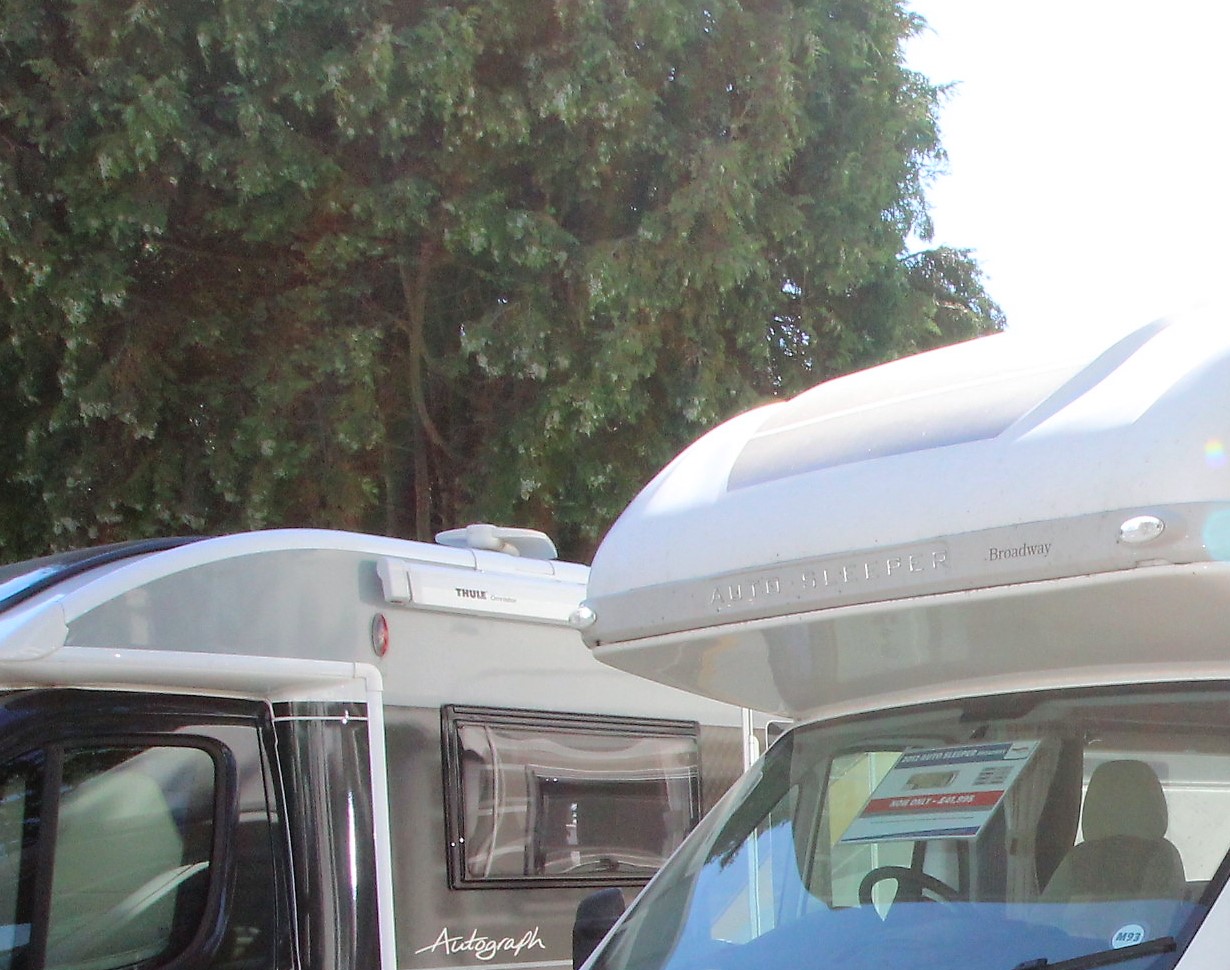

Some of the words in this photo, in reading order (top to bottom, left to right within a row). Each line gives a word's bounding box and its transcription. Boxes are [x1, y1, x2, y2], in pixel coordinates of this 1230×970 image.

[988, 542, 1052, 561] Broadway
[710, 578, 781, 604] AUTO
[801, 549, 949, 588] SLEEPER
[455, 587, 487, 600] THULE
[910, 797, 932, 806] ONLY
[415, 926, 546, 961] Autograph
